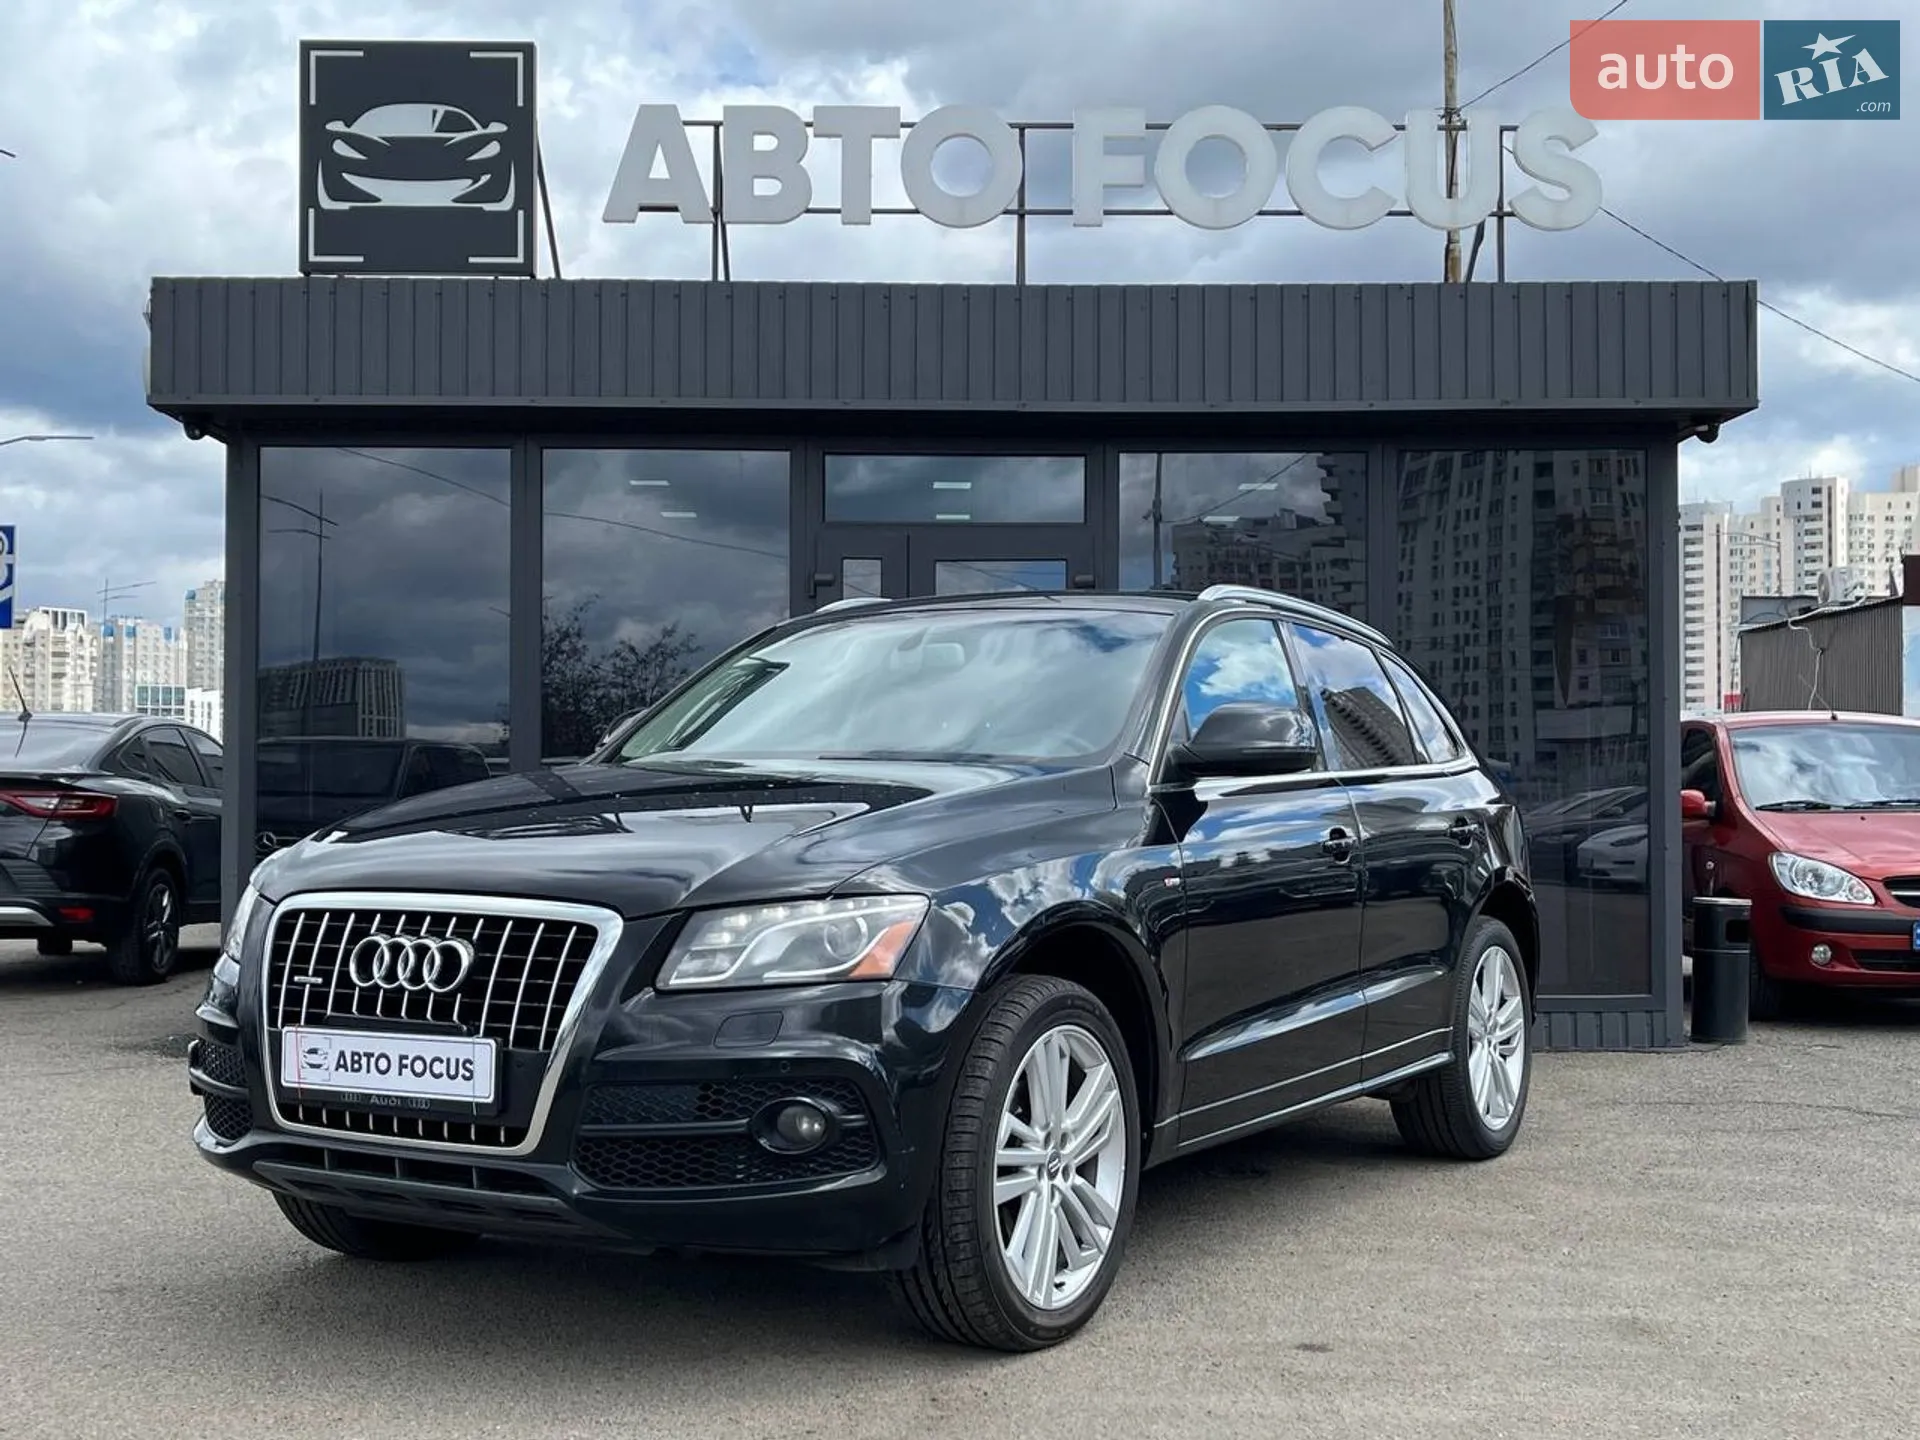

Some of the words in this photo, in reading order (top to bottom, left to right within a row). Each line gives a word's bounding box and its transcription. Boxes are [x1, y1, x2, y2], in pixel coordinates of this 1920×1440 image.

[602, 104, 1023, 228] АВТО
[1073, 105, 1603, 231] FOCUS
[334, 1049, 391, 1076] АВТО
[398, 1054, 475, 1082] FOCUS
